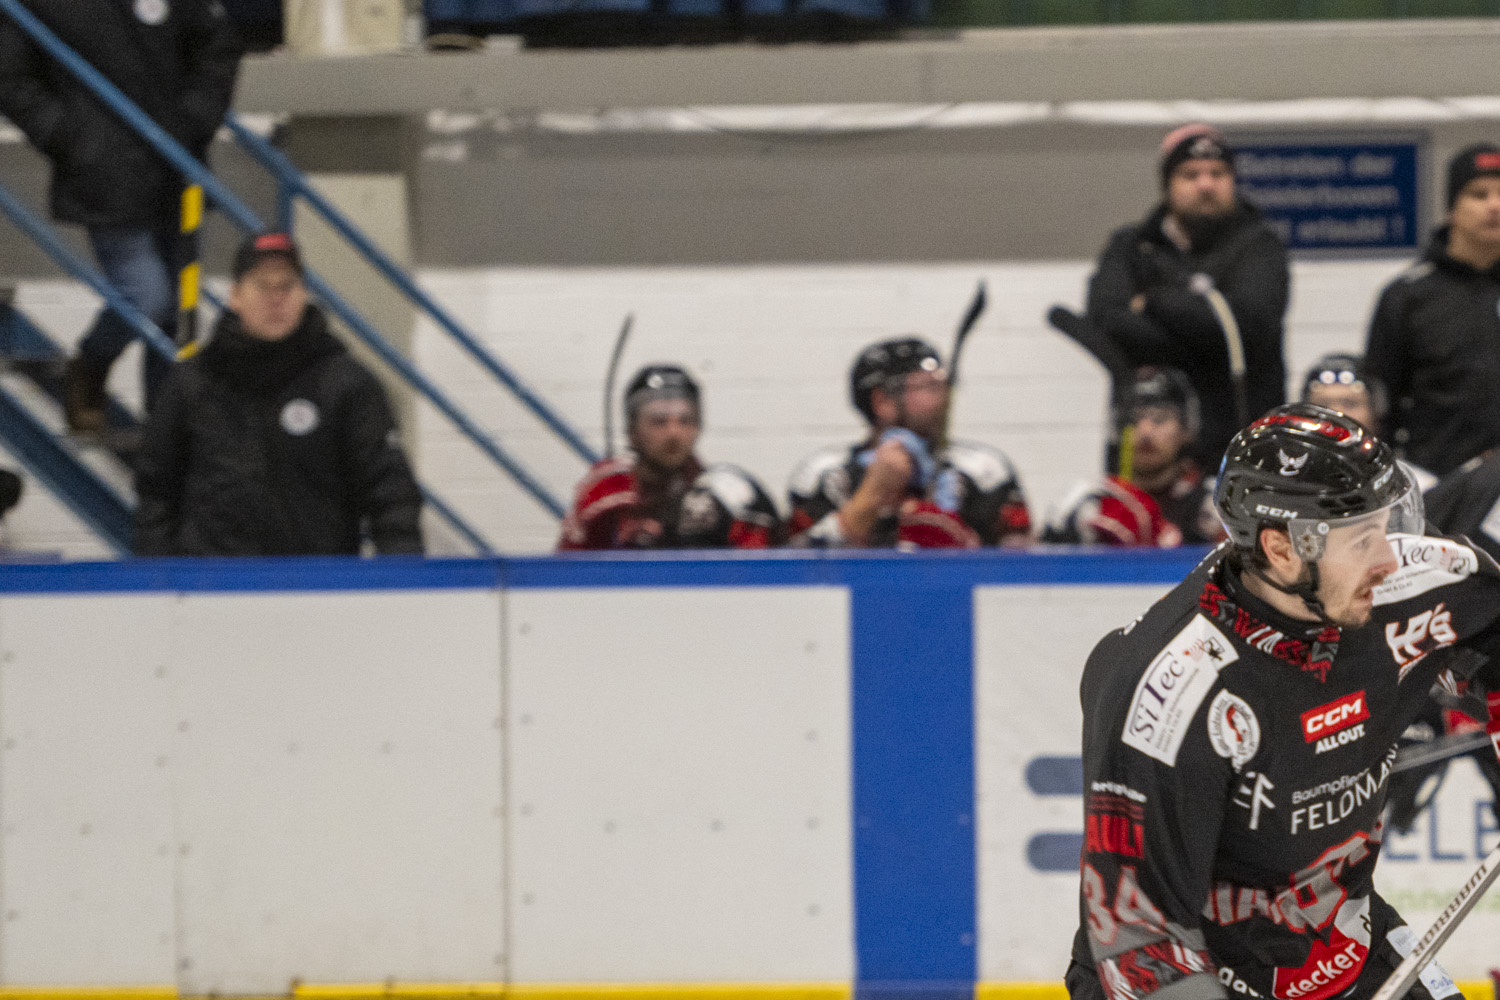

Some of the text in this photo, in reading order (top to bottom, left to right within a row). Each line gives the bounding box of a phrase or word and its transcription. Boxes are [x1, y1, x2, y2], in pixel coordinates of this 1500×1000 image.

[1255, 503, 1298, 519] CCM
[1306, 698, 1363, 734] CCM
[1291, 743, 1399, 835] FELDMAN
[1411, 863, 1488, 958] WARRIOR
[1286, 942, 1362, 998] decker
